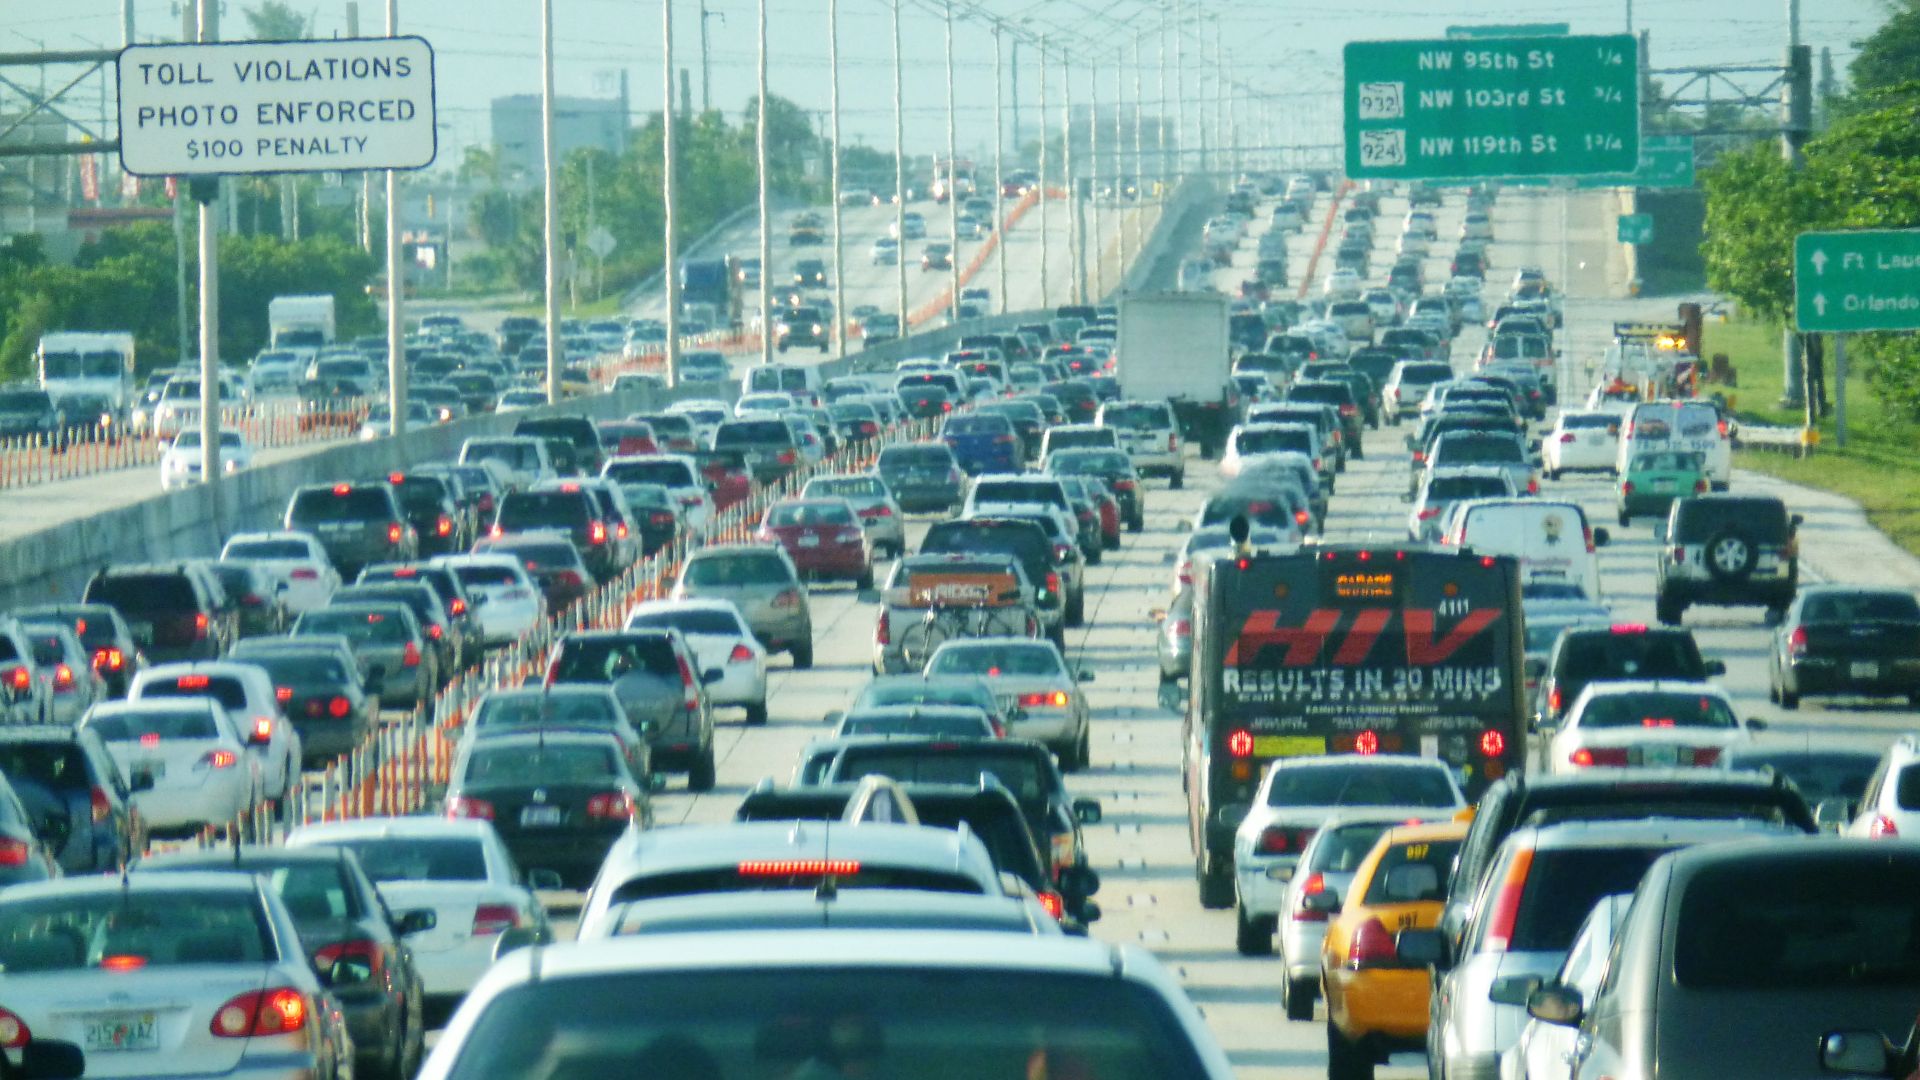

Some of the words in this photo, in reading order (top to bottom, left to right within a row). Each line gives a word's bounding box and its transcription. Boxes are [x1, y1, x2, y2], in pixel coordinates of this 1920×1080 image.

[1418, 51, 1453, 70] NW
[1463, 50, 1519, 70] 95th
[1527, 49, 1555, 69] St
[138, 63, 214, 85] TOLL
[234, 56, 412, 83] VIOLATIONS
[1361, 96, 1396, 113] 932
[1419, 89, 1454, 108] NW
[1464, 89, 1529, 107] 103rd
[1540, 88, 1566, 105] St
[137, 104, 239, 128] PHOTO
[257, 99, 415, 125] ENFORCED
[187, 139, 243, 159] $100
[257, 136, 368, 156] PENALTY
[1362, 143, 1397, 160] 924
[1420, 138, 1454, 156] NW
[1463, 136, 1522, 154] 119th
[1531, 134, 1557, 152] St
[1843, 252, 1865, 269] Ft
[1844, 294, 1920, 312] Orlando
[1438, 598, 1469, 618] 4111
[1222, 608, 1502, 667] HIV
[1223, 667, 1345, 693] RESULTS
[1355, 668, 1383, 693] IN
[1432, 667, 1502, 693] MINS
